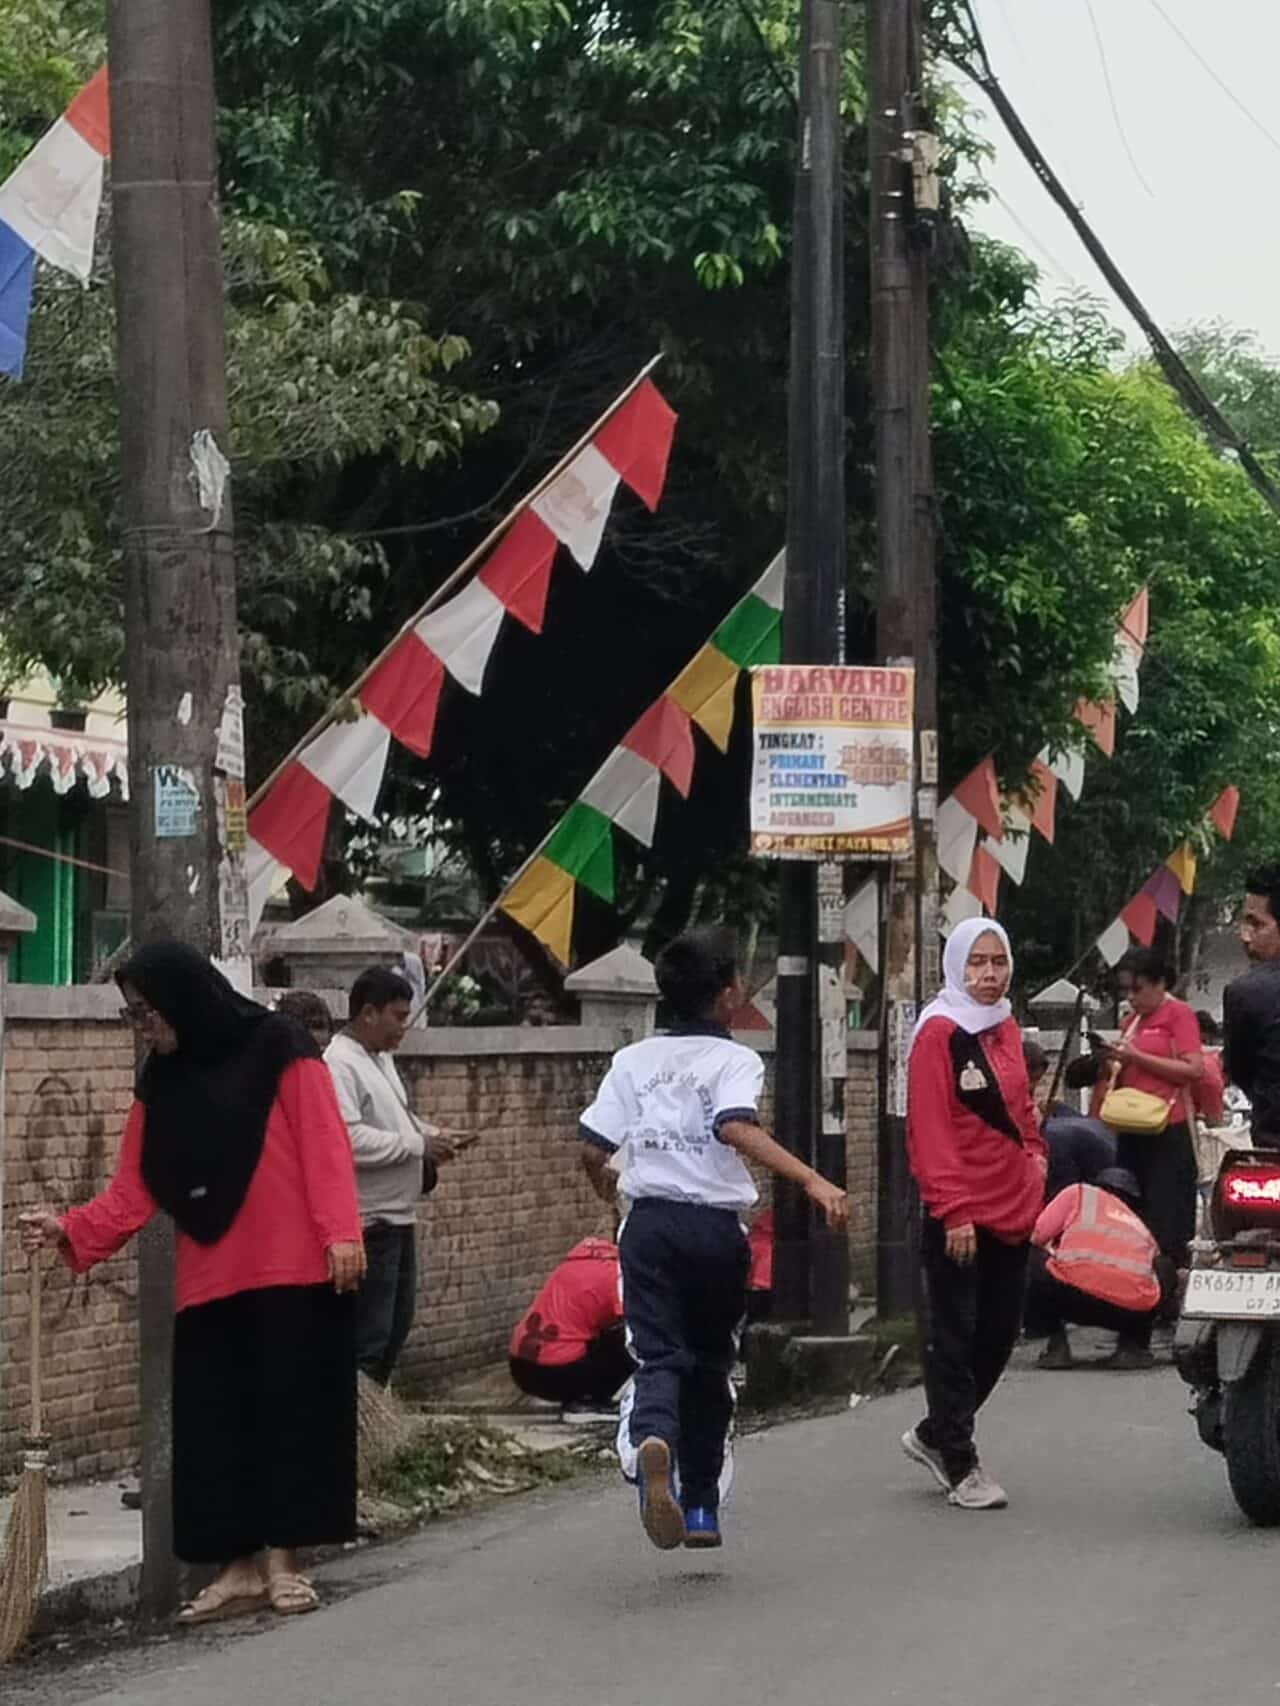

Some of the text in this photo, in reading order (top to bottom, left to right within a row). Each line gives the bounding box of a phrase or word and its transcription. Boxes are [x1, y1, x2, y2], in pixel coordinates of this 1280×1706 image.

[763, 668, 907, 697] HARVARD
[761, 695, 908, 723] ENGLISH CENTRE
[759, 732, 816, 750] TINGKAT
[769, 754, 826, 769] PRIMARY
[769, 773, 848, 788] ELEMENTARY
[769, 793, 858, 808] INTERMEDIATE
